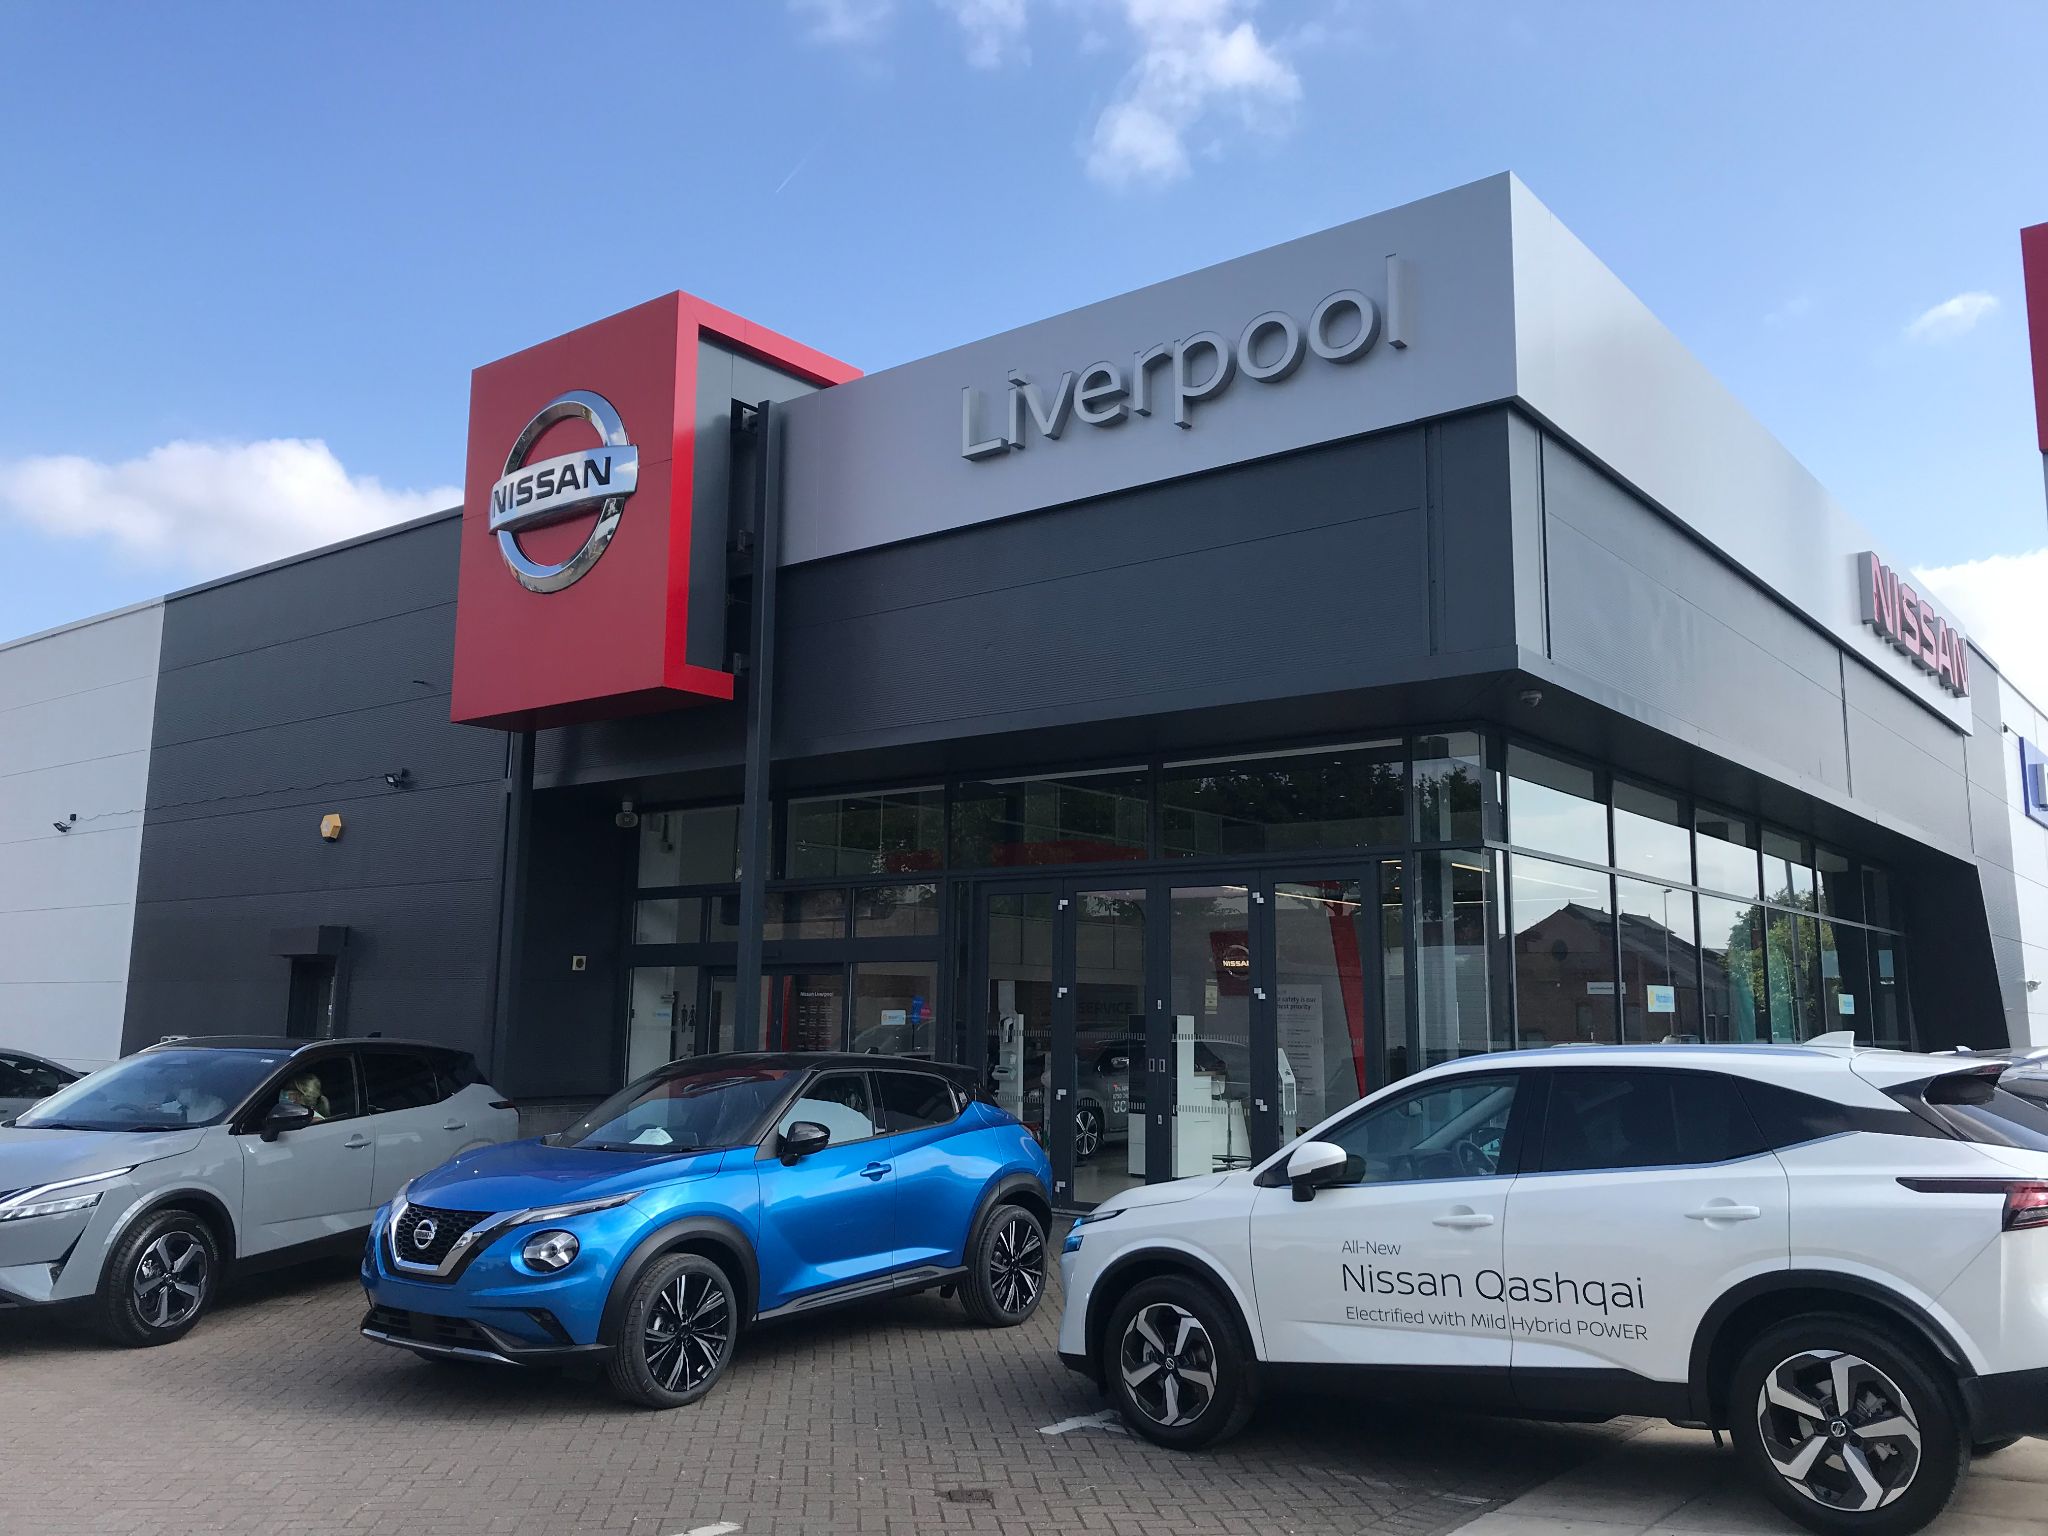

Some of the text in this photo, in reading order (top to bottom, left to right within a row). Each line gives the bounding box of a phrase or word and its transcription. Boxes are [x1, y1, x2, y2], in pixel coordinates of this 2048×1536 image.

[962, 253, 1407, 461] Liverpool
[492, 457, 612, 518] NISSAN
[1858, 550, 1970, 698] NISSAN
[1341, 1240, 1401, 1256] All-New
[1342, 1263, 1645, 1316] Nissan Qashqai
[1346, 1306, 1649, 1341] Electrified with Mild Hybrid POWER
